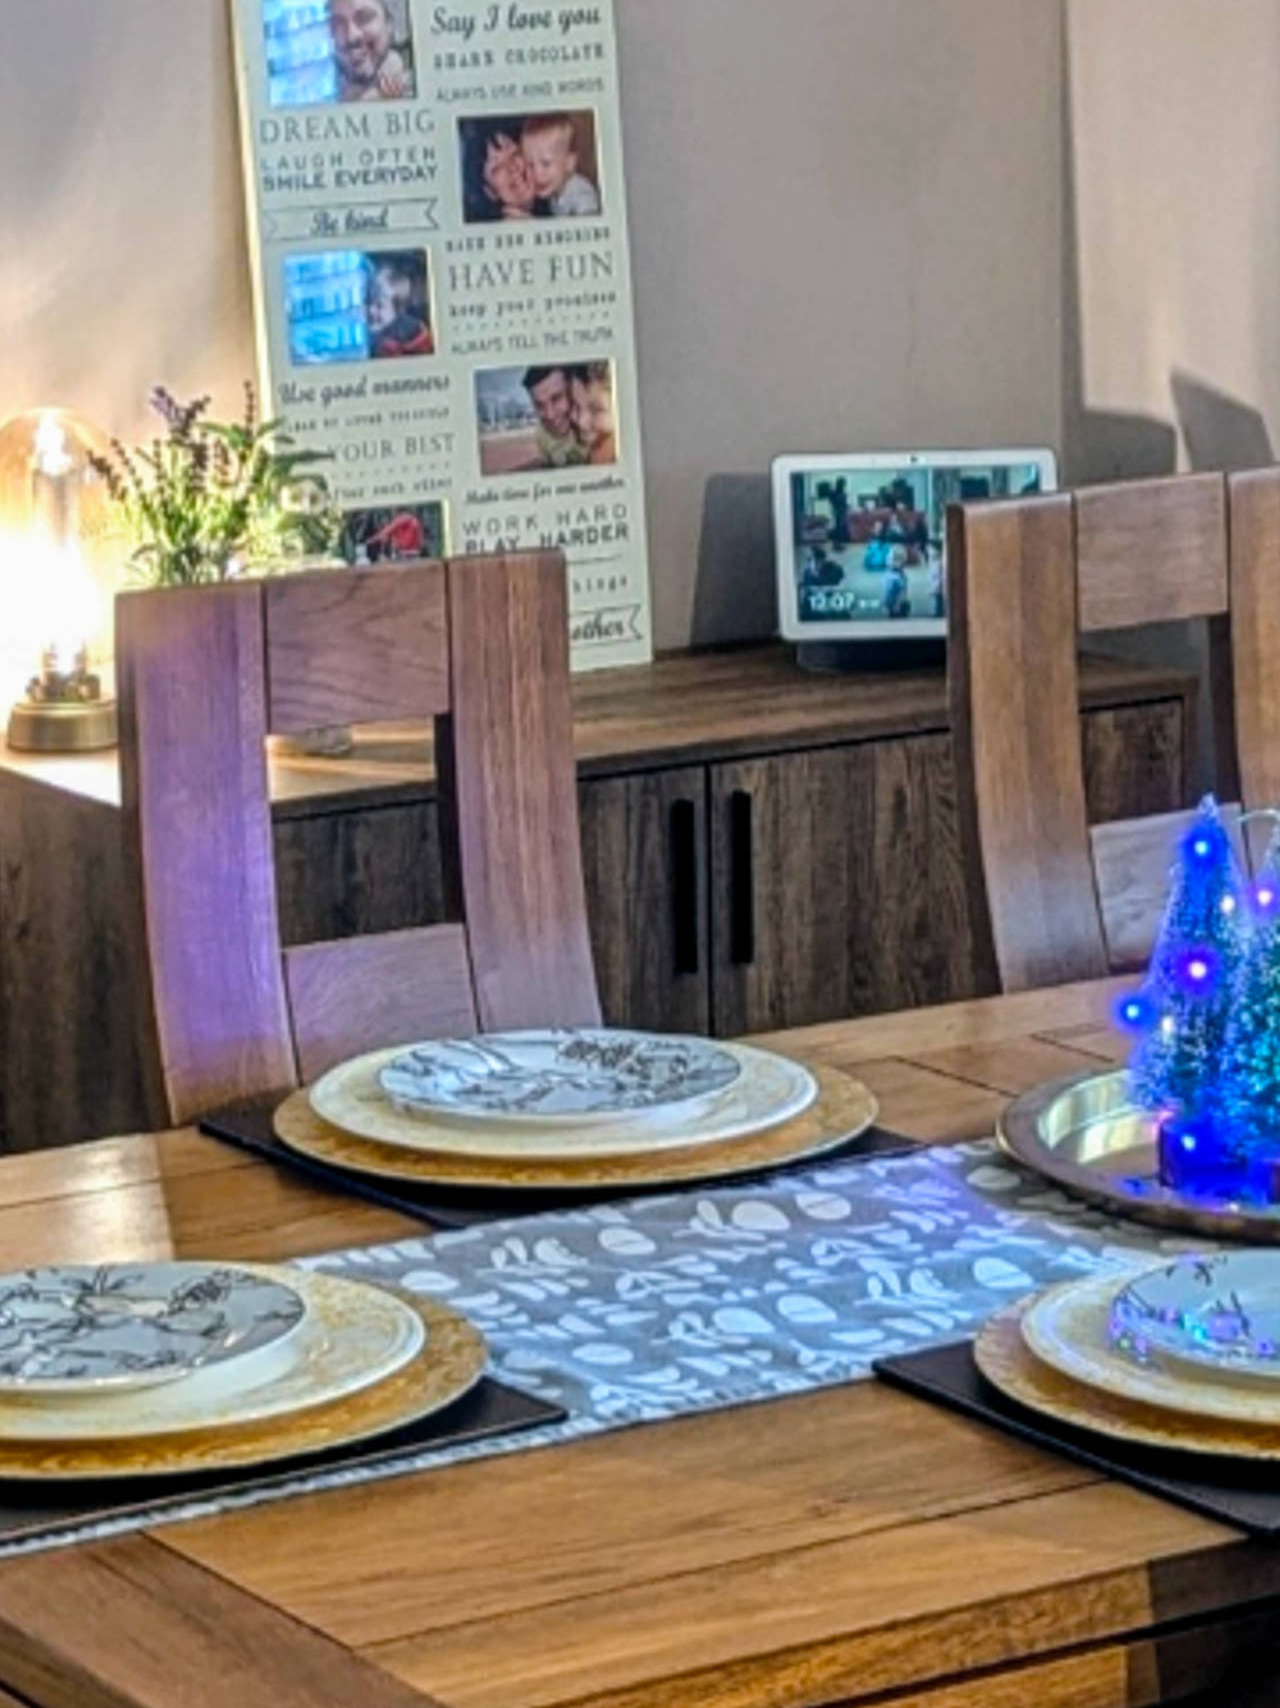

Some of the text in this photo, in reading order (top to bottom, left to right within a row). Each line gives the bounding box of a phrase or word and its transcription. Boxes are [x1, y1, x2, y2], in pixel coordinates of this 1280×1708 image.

[430, 5, 475, 40] Say
[507, 3, 552, 30] love
[558, 7, 602, 35] you
[259, 108, 436, 144] DREAM BIG
[261, 146, 436, 172] LAUGH OFTEN
[262, 164, 438, 192] SMILE EVERYDAY
[345, 205, 389, 232] kind
[449, 251, 613, 291] HAVE FUN
[321, 375, 368, 408] good
[373, 375, 450, 395] manners
[405, 433, 455, 456] BEST
[462, 503, 627, 536] WORK HARD
[465, 521, 629, 554] PLAY HARDER
